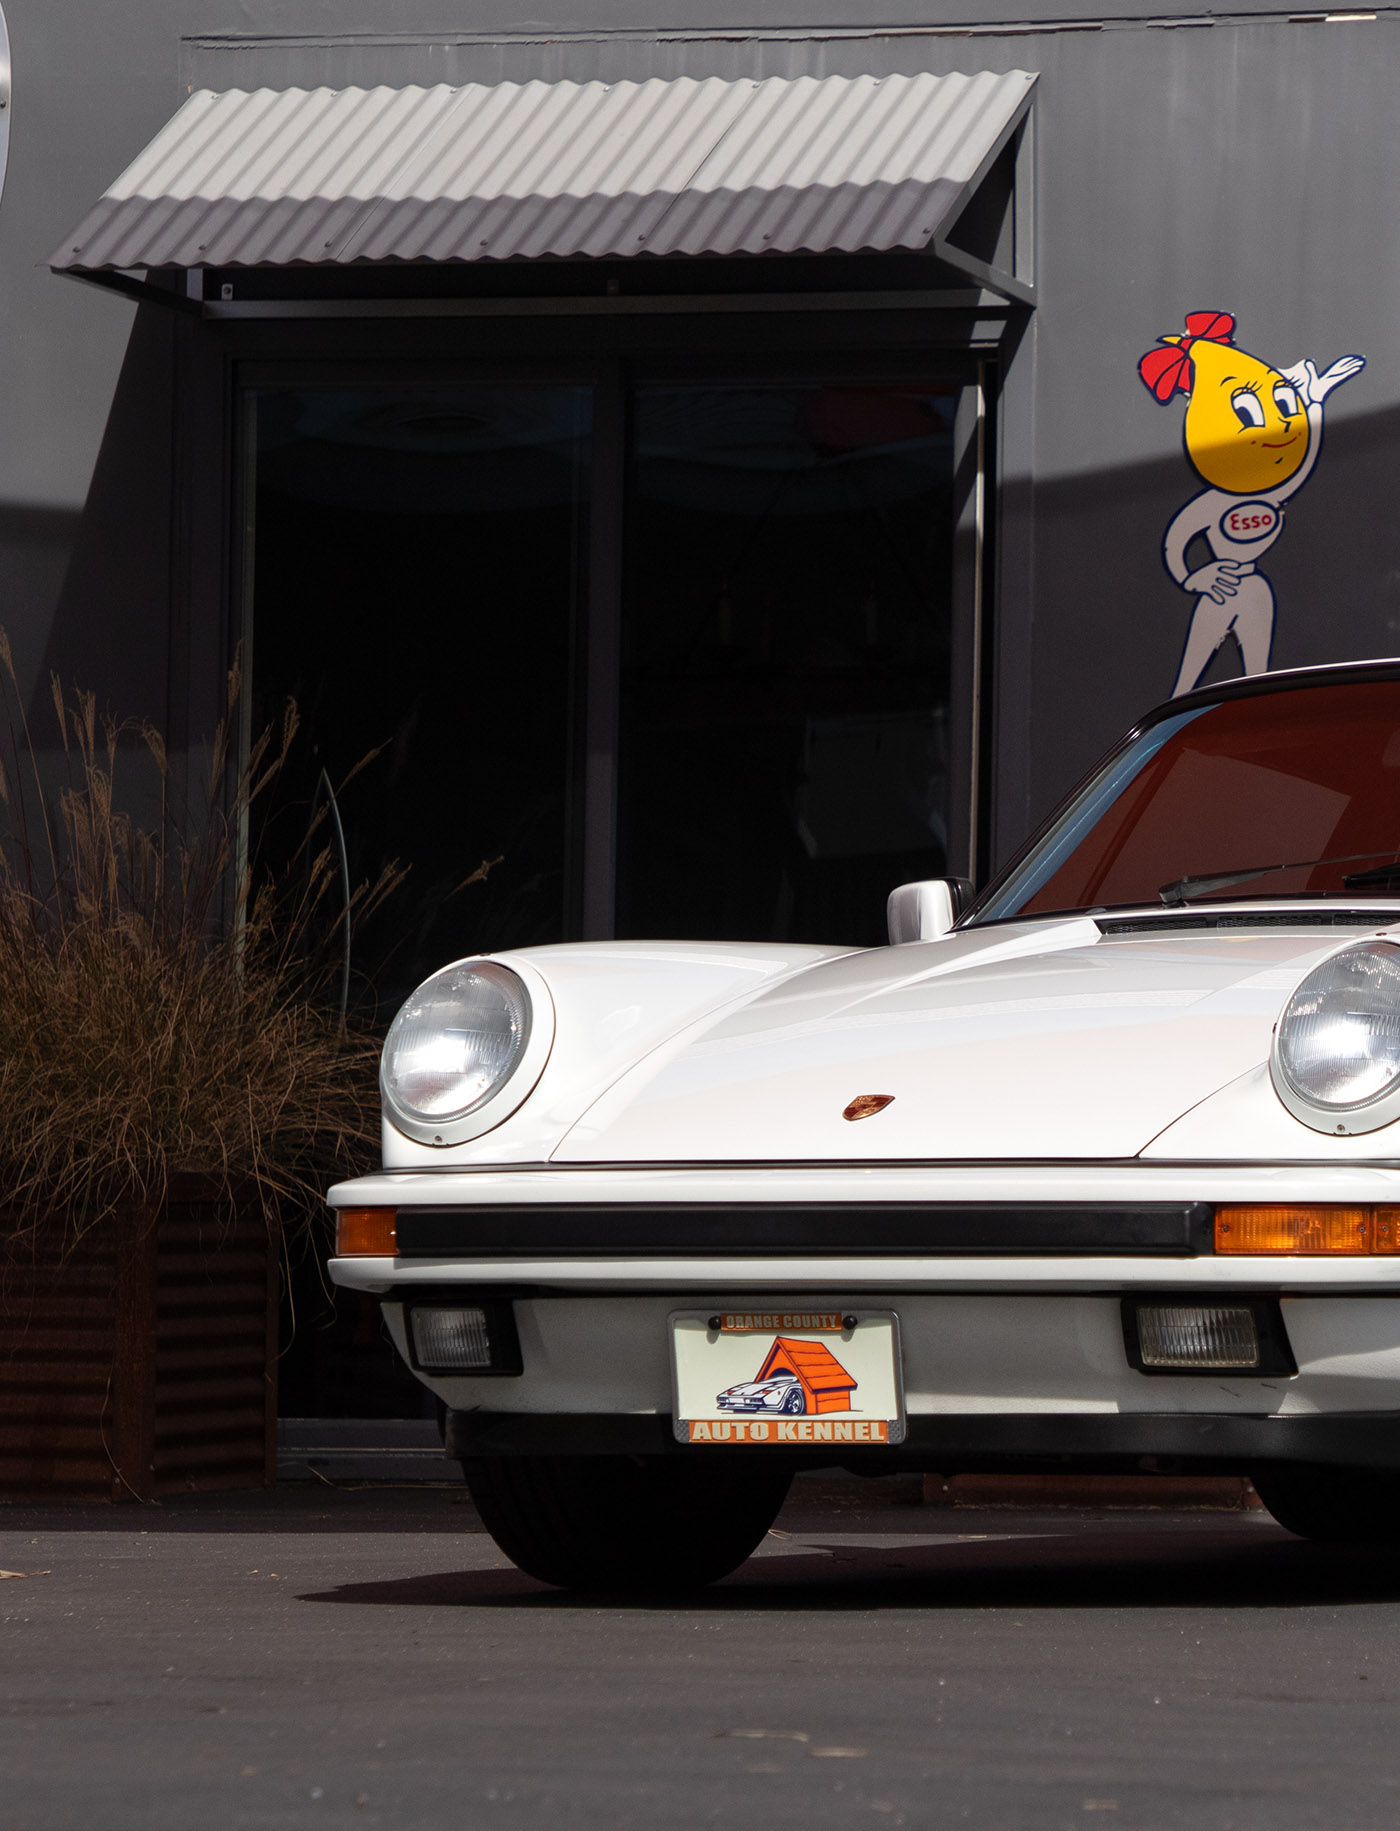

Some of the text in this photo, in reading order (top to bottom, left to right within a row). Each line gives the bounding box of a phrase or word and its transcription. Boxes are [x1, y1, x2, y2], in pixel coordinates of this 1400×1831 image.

[1230, 513, 1272, 531] Esso
[726, 1314, 837, 1329] ORANGE COUNTY
[692, 1421, 885, 1441] AUTO KENNEL
